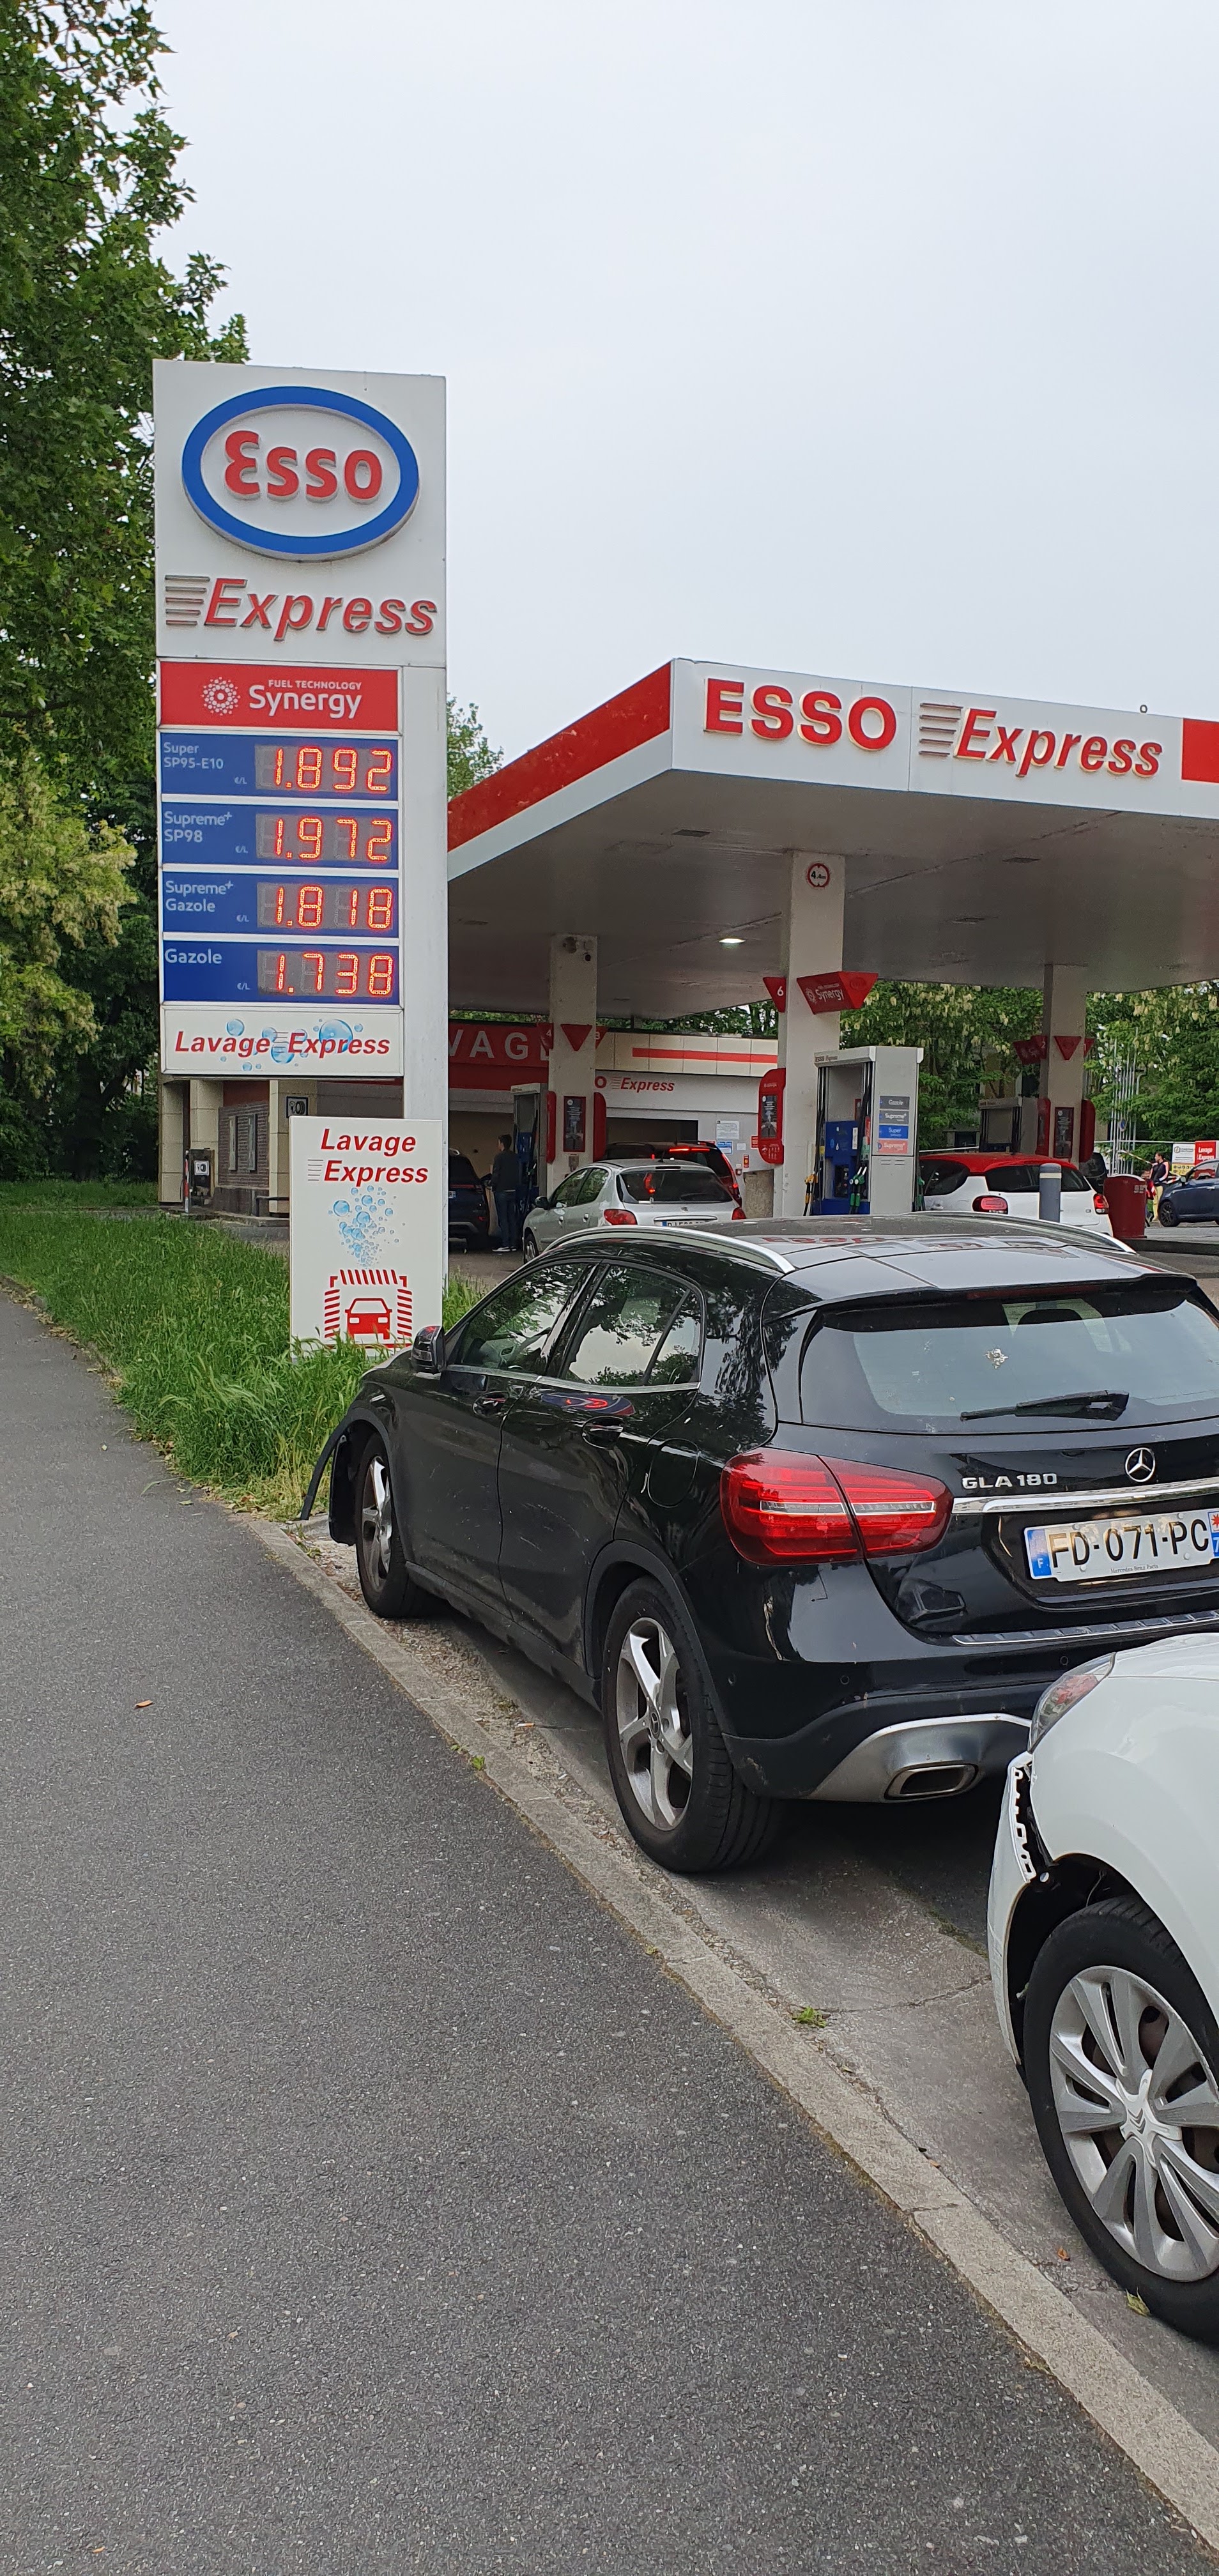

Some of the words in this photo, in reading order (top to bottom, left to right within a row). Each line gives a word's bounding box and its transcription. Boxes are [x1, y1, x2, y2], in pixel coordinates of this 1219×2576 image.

[224, 429, 383, 502] Esso
[204, 578, 438, 641] Express
[268, 679, 293, 688] FUEL
[295, 680, 362, 691] TECHNOLOGY
[249, 684, 362, 719] Synergy
[704, 677, 897, 751] ESSO
[953, 707, 1163, 778] Express
[164, 742, 199, 756] Super
[164, 756, 224, 769] SP95-E10
[274, 747, 392, 792] 1.892
[164, 829, 203, 843] SP98
[274, 817, 392, 861] 1.972
[165, 898, 216, 912] Gazole
[275, 886, 394, 929] 1.818
[165, 948, 222, 964] Gazole
[277, 953, 394, 995] 1.738
[777, 986, 784, 997] 6
[815, 988, 844, 1002] Synergy
[175, 1030, 270, 1058] Lavage
[288, 1032, 391, 1059] Express
[620, 1077, 675, 1093] Express
[321, 1128, 416, 1157] Lavage
[324, 1160, 429, 1187] Express
[962, 1476, 1013, 1489] GLA
[1016, 1473, 1057, 1487] 180
[1048, 1519, 1209, 1568] FD-071-PC
[1037, 1558, 1044, 1568] F
